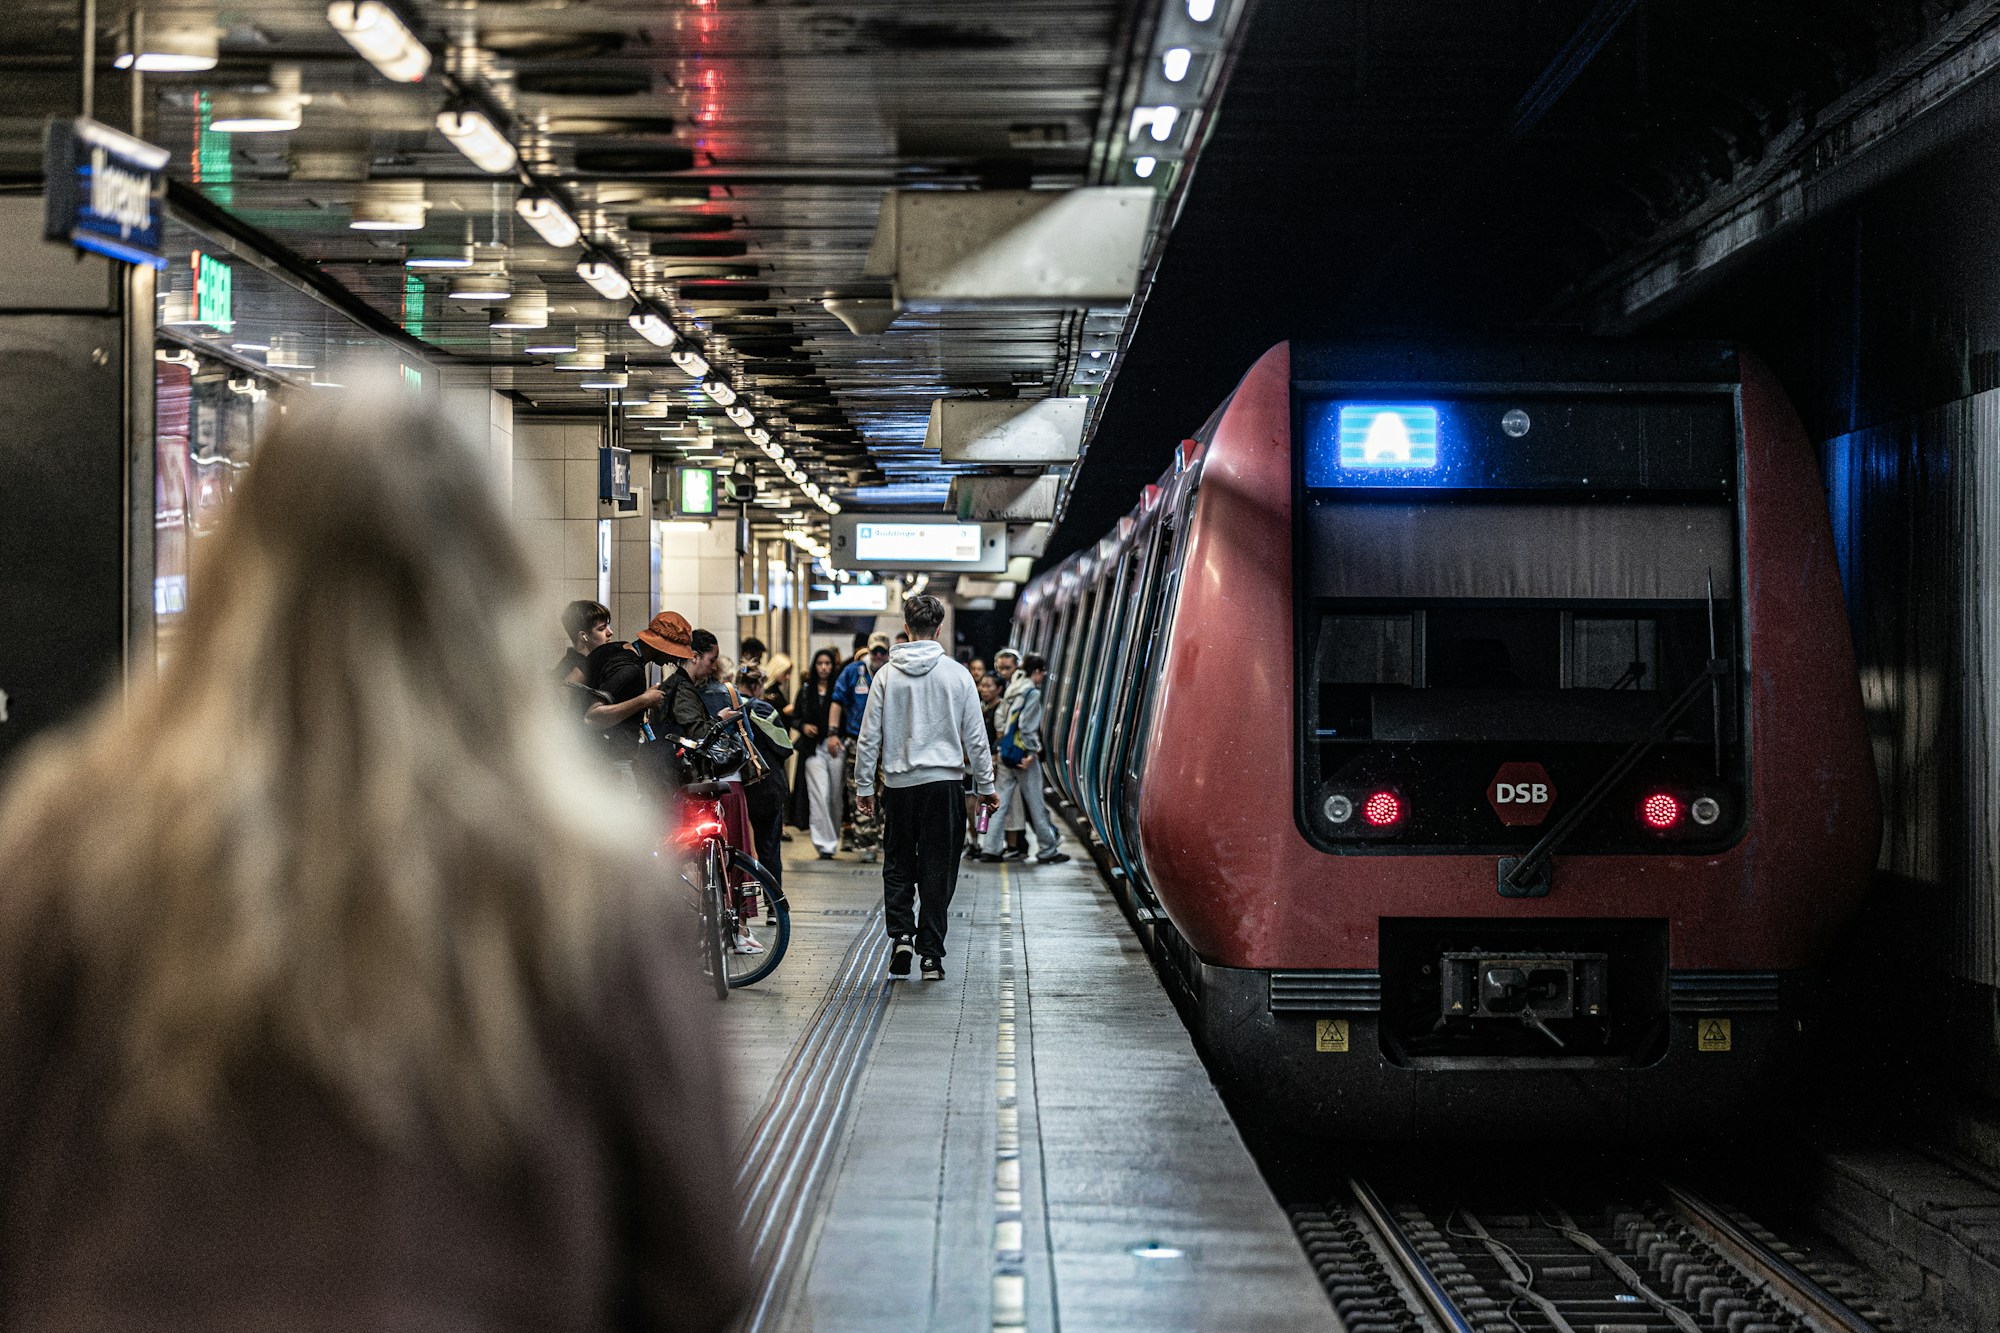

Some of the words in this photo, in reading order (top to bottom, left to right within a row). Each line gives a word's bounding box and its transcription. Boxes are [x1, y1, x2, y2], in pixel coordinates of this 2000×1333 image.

[1364, 412, 1410, 462] A
[838, 535, 846, 547] 3
[1497, 783, 1548, 803] DSB
